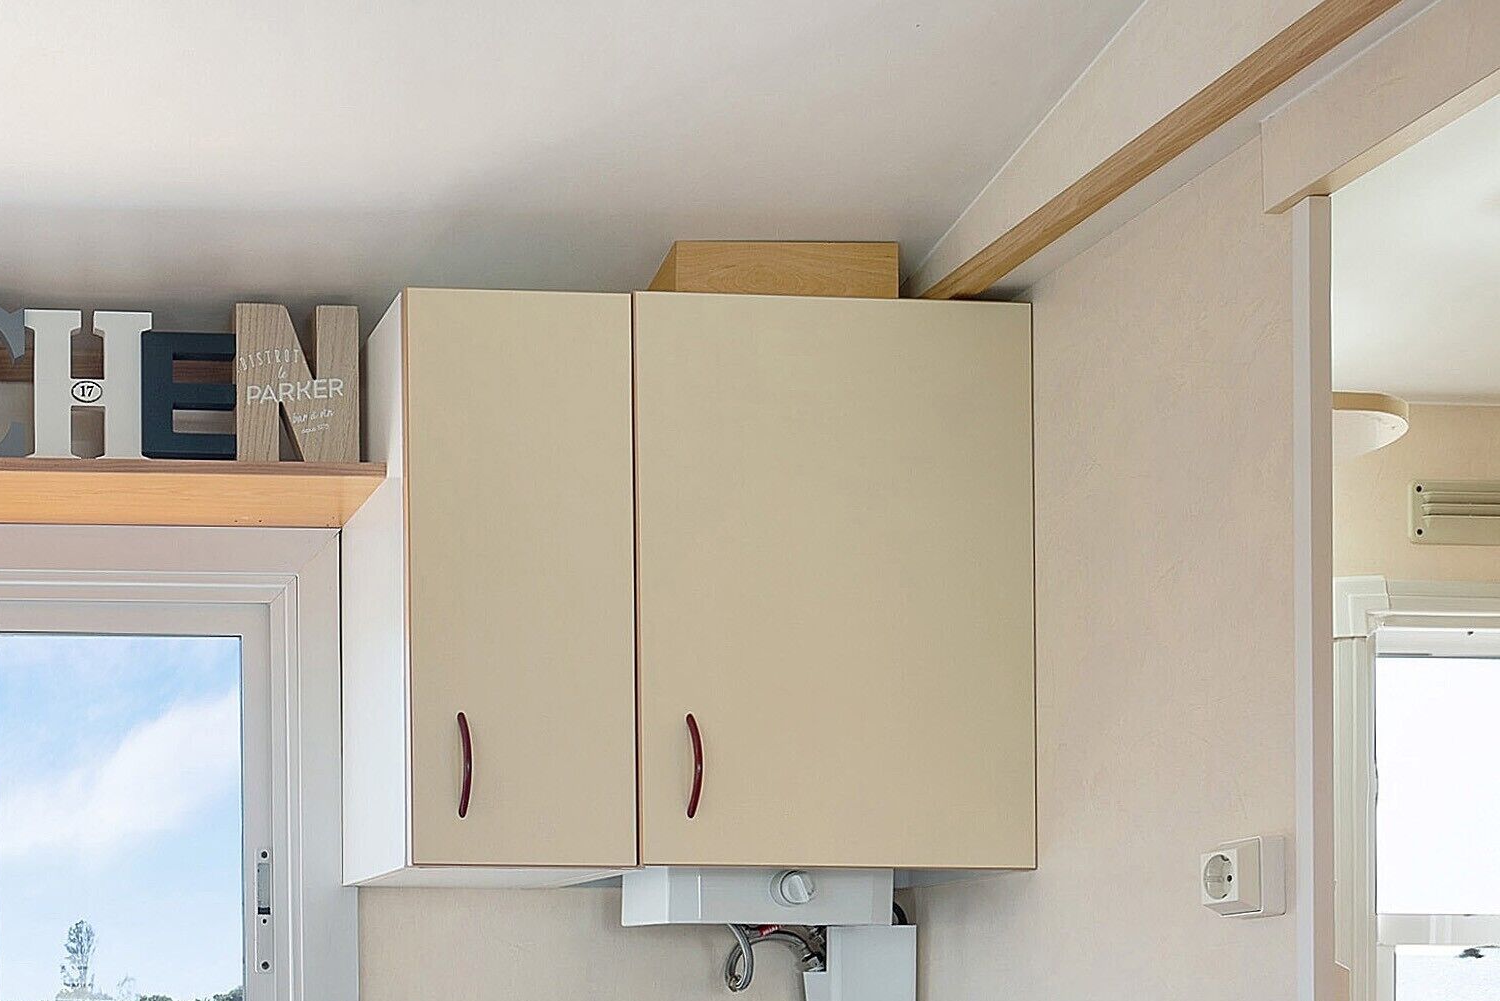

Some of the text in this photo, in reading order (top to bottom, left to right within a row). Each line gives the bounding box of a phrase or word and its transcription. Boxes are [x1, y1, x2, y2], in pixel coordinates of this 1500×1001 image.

[239, 348, 300, 371] BISTROT
[80, 385, 95, 398] 17
[246, 378, 344, 406] PARKER
